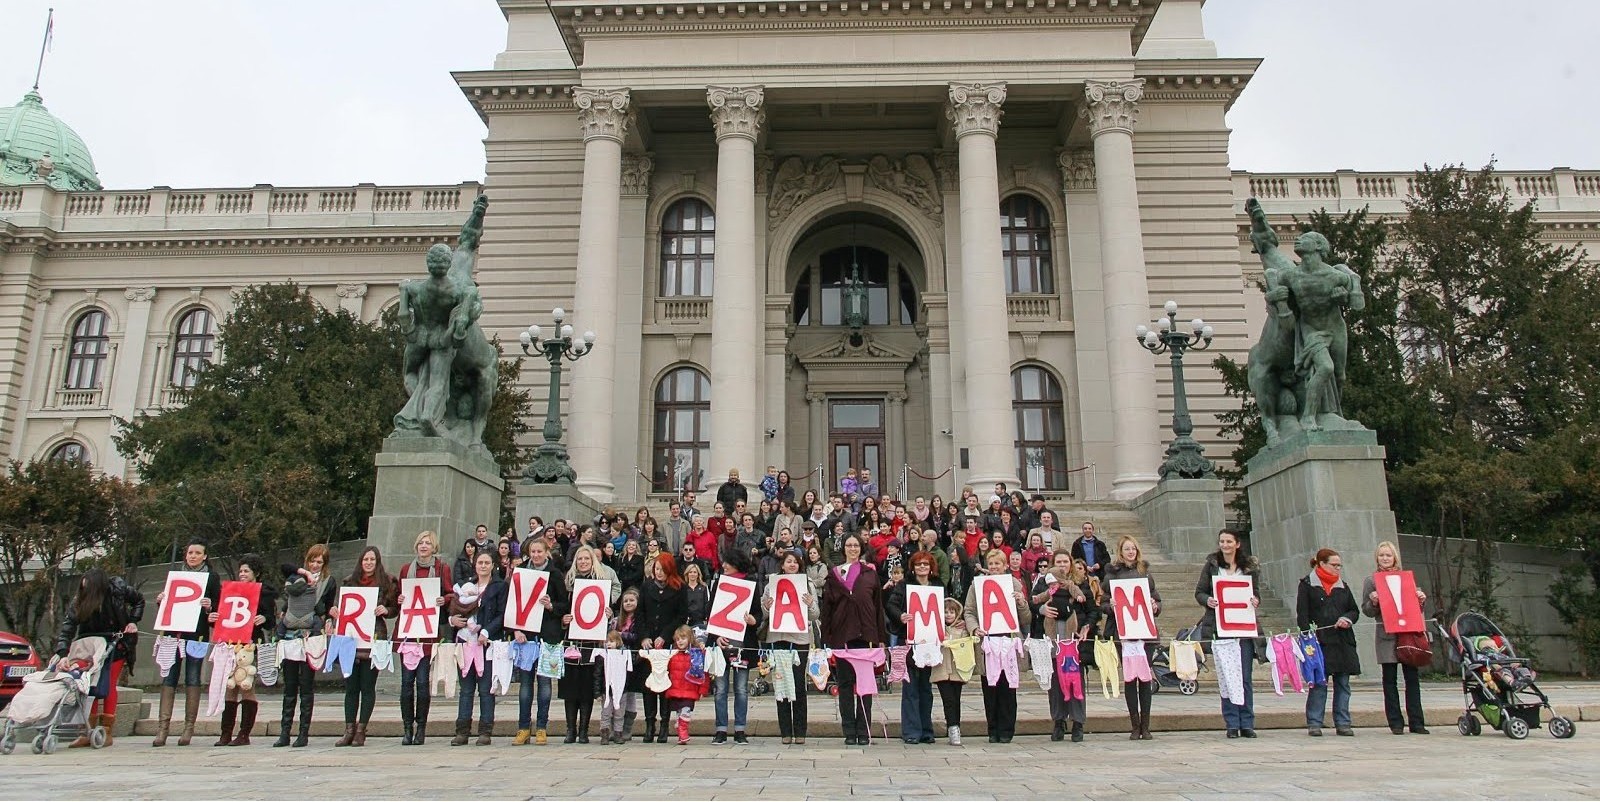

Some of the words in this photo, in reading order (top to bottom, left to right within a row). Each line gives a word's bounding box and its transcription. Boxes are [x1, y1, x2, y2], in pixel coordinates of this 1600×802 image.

[162, 579, 202, 626] P
[337, 593, 371, 641] R
[403, 586, 437, 633] A
[512, 573, 545, 629] V
[709, 582, 746, 631] Z
[773, 578, 805, 630] A
[908, 592, 946, 641] M
[983, 580, 1016, 631] A
[1114, 586, 1157, 637] M
[1216, 580, 1255, 630] E
